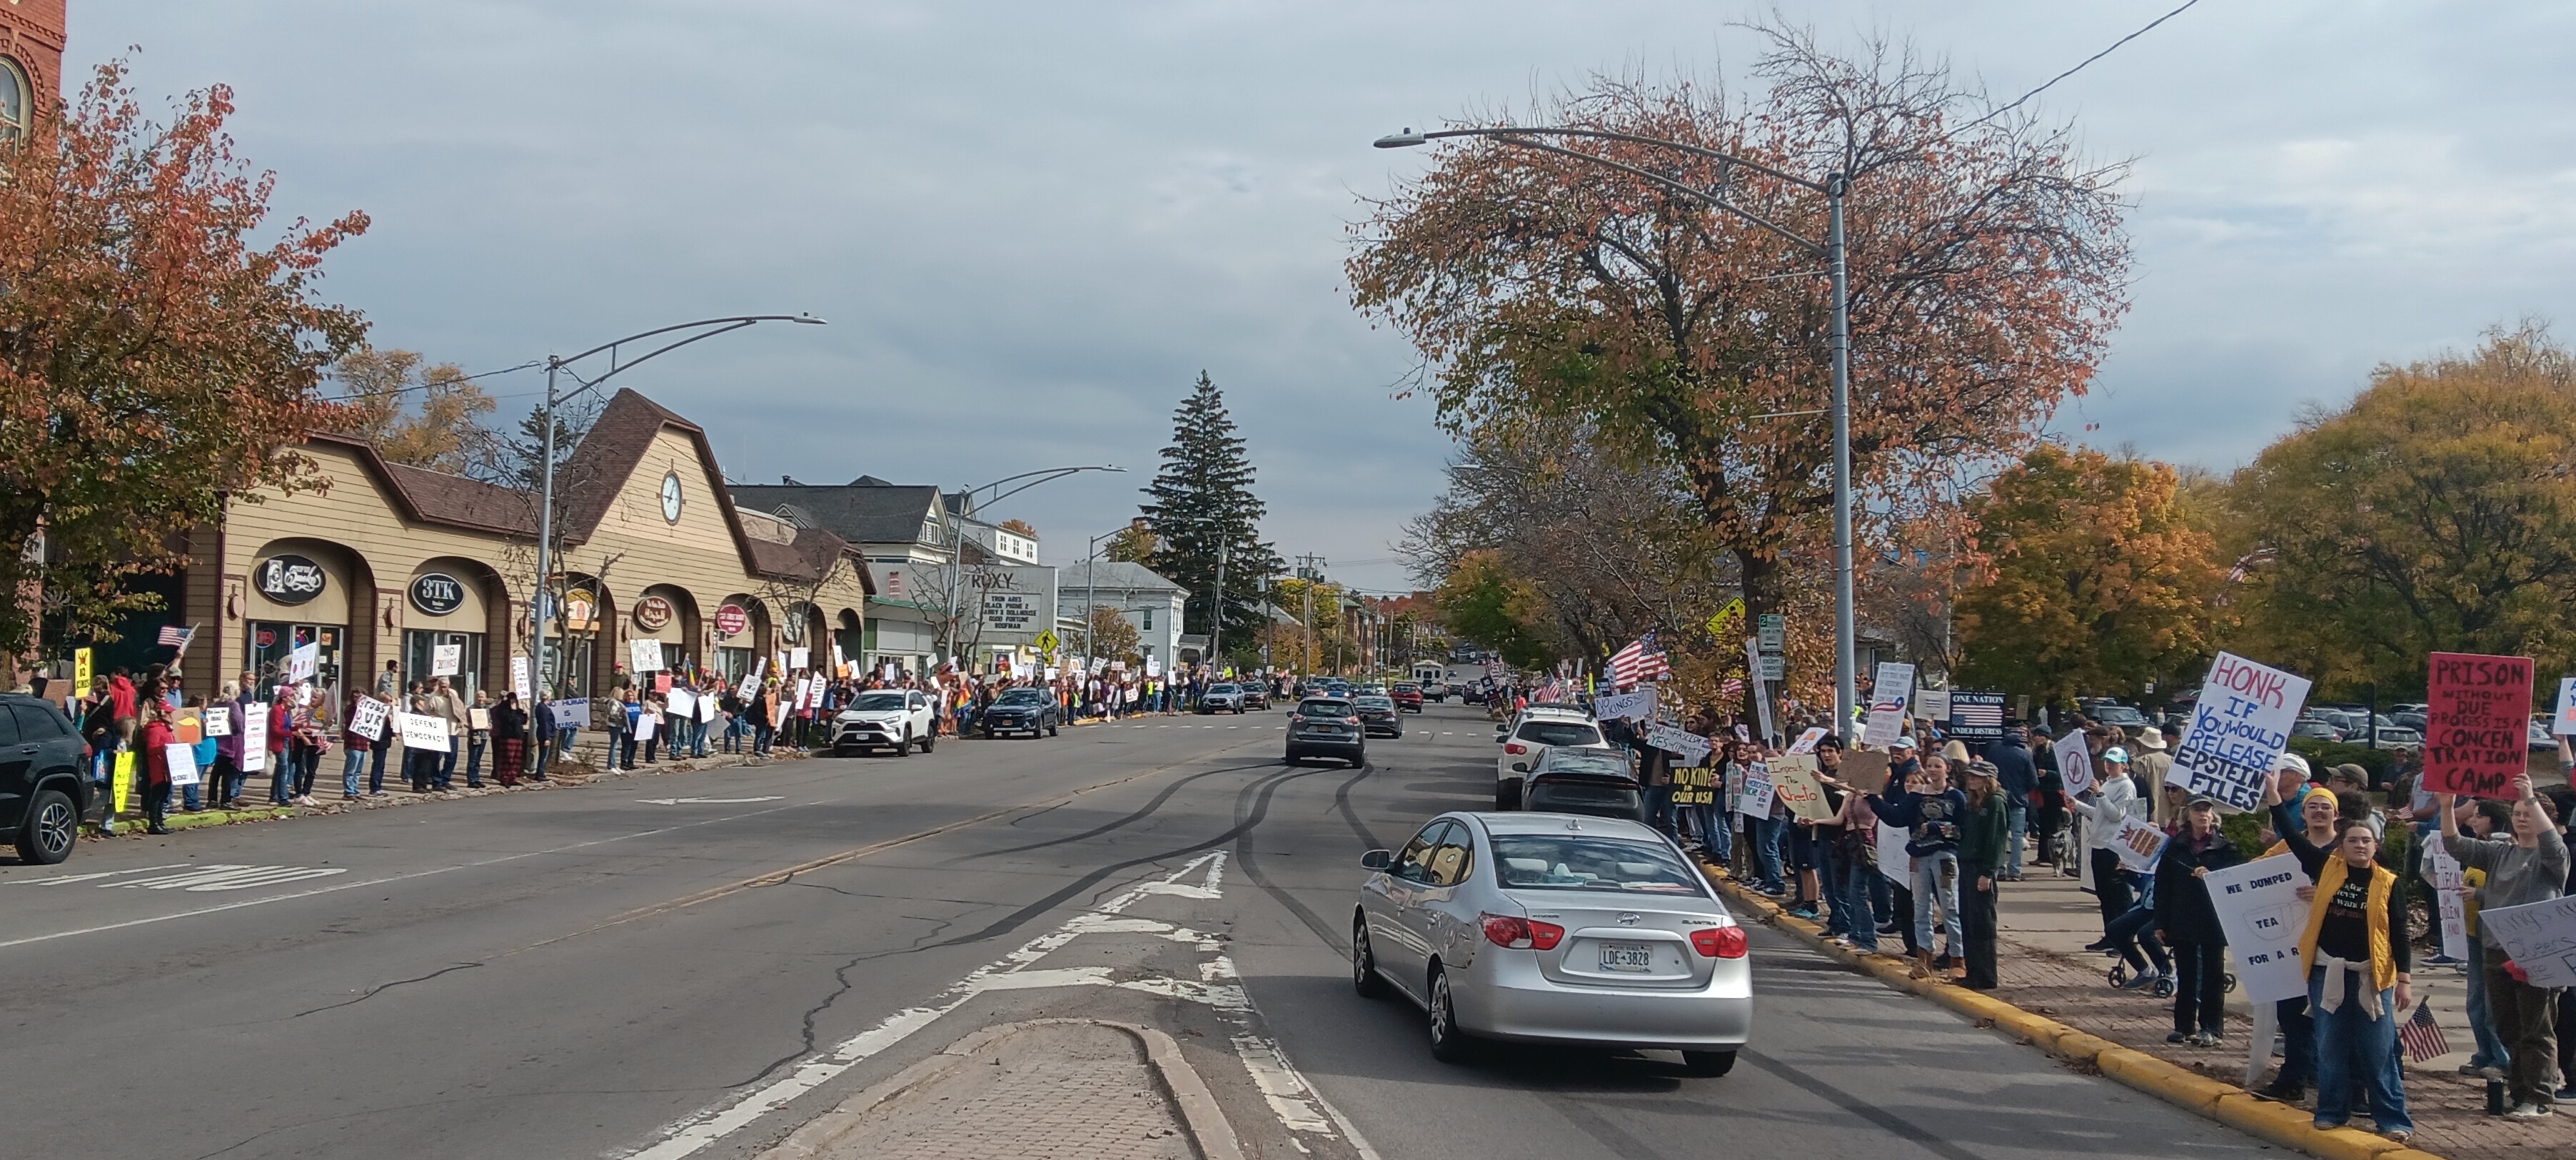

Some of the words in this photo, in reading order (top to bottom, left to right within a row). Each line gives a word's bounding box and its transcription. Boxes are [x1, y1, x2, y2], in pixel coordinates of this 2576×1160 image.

[423, 578, 455, 600] 3TK
[972, 573, 1013, 589] ROXY
[1760, 617, 1767, 626] 2
[443, 647, 455, 657] NO
[2437, 660, 2525, 686] PRISON
[2212, 655, 2288, 710] HONK
[2442, 690, 2514, 701] WITHOUT
[358, 696, 386, 714] Grabs
[1596, 698, 1609, 711] NO
[1609, 697, 1633, 716] KINGS
[2224, 695, 2259, 720] IF
[2456, 700, 2492, 716] DUE
[356, 709, 382, 727] OUR
[410, 718, 437, 729] DEFEND
[2430, 712, 2490, 728] PROCESS
[2492, 717, 2510, 729] IS
[2512, 718, 2523, 729] A
[405, 730, 445, 742] DEMOCRACY
[1651, 735, 1669, 747] YES
[1654, 726, 1665, 735] NO
[1672, 730, 1702, 744] FASCISM
[2439, 728, 2513, 749] CONCEN
[2187, 729, 2278, 772] RELEASE
[2430, 747, 2522, 765] TRATION
[1768, 758, 1806, 775] Impeach
[2174, 745, 2265, 791] EPSTEIN
[1674, 768, 1690, 785] NO
[1784, 775, 1798, 785] The
[2445, 767, 2506, 795] CAMP
[1671, 791, 1694, 803] OUR
[1695, 791, 1714, 805] USA
[1777, 784, 1818, 802] Cheeto
[2188, 772, 2260, 812] FILES
[2225, 884, 2243, 894] WE
[2250, 872, 2293, 889] DUMPED
[2255, 917, 2279, 929] TEA
[2491, 909, 2551, 934] Kings
[2248, 954, 2270, 965] FOR
[2276, 949, 2285, 960] A
